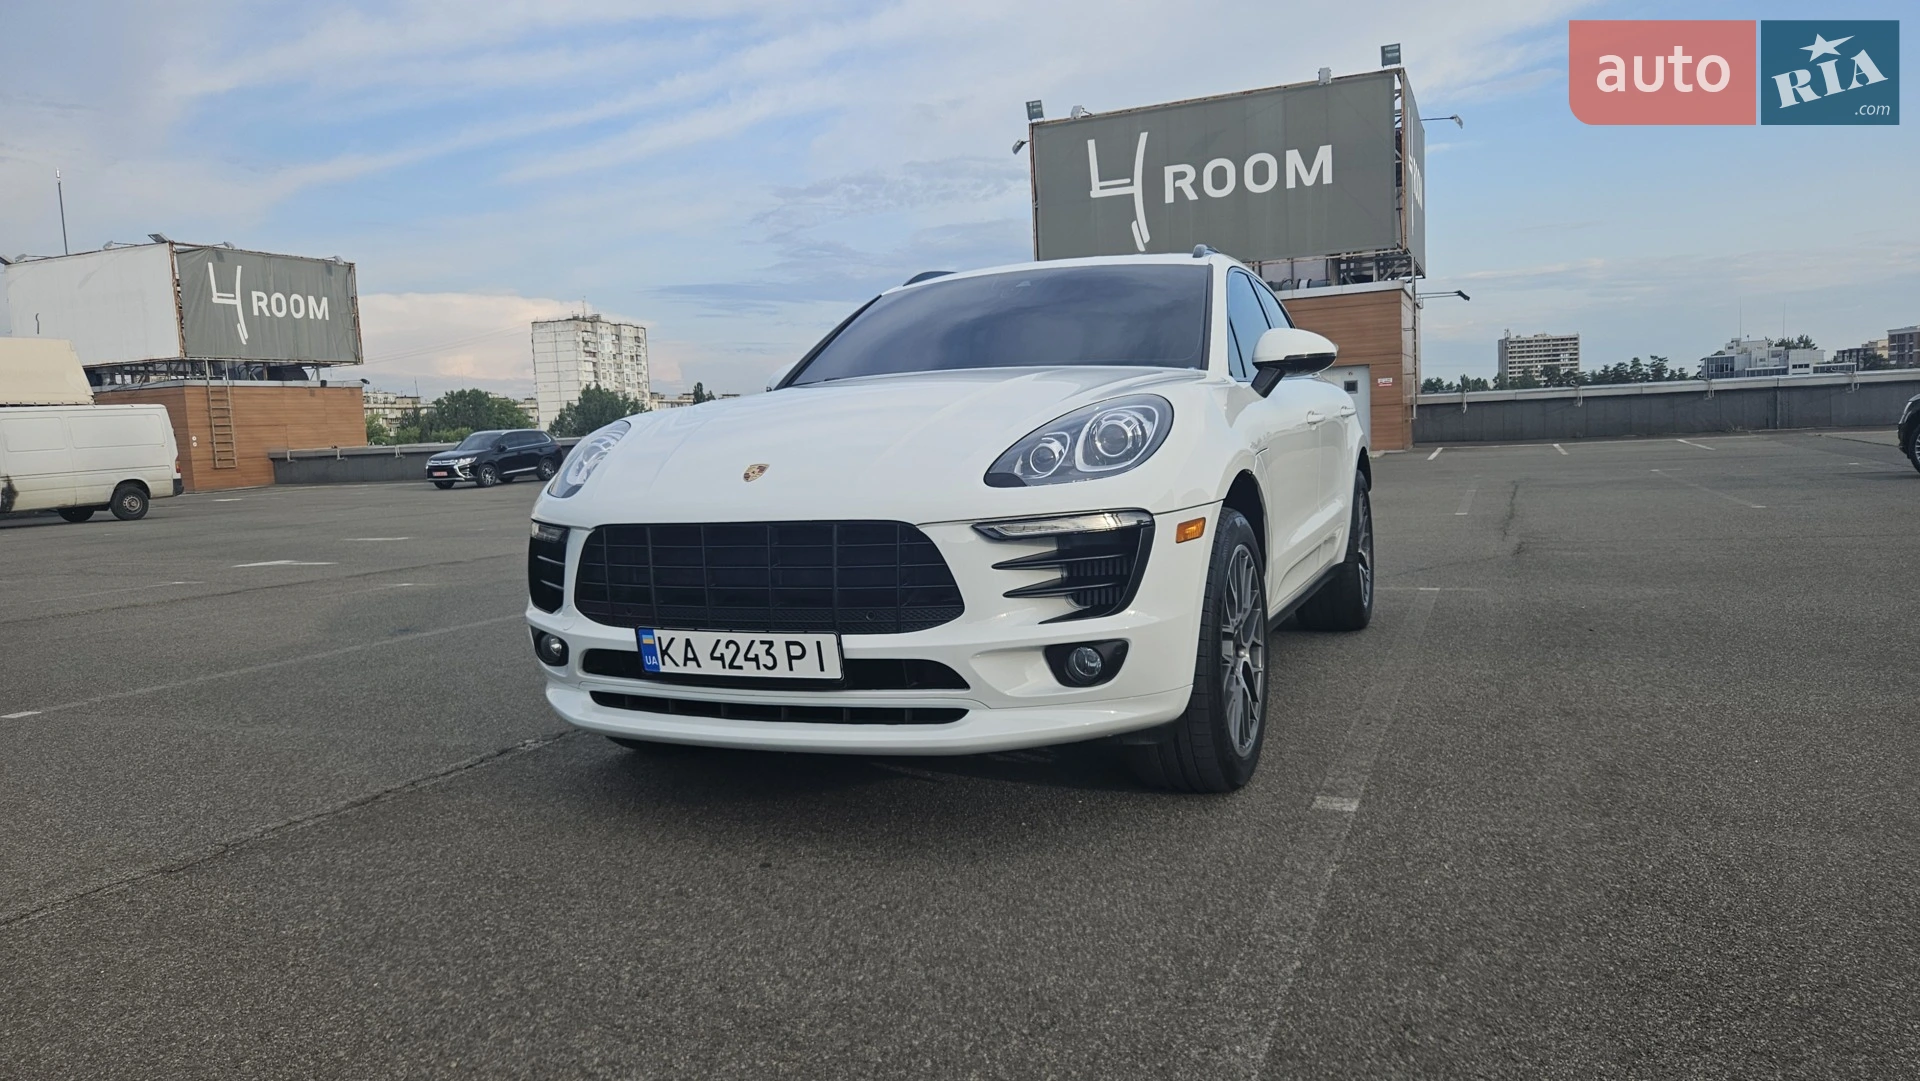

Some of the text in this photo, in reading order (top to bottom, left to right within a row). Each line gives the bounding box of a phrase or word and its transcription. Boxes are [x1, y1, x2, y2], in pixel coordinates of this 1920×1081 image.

[1164, 144, 1333, 204] ROOM
[251, 290, 330, 321] ROOM
[645, 655, 658, 666] UA
[657, 636, 825, 672] KA 4243 PI
